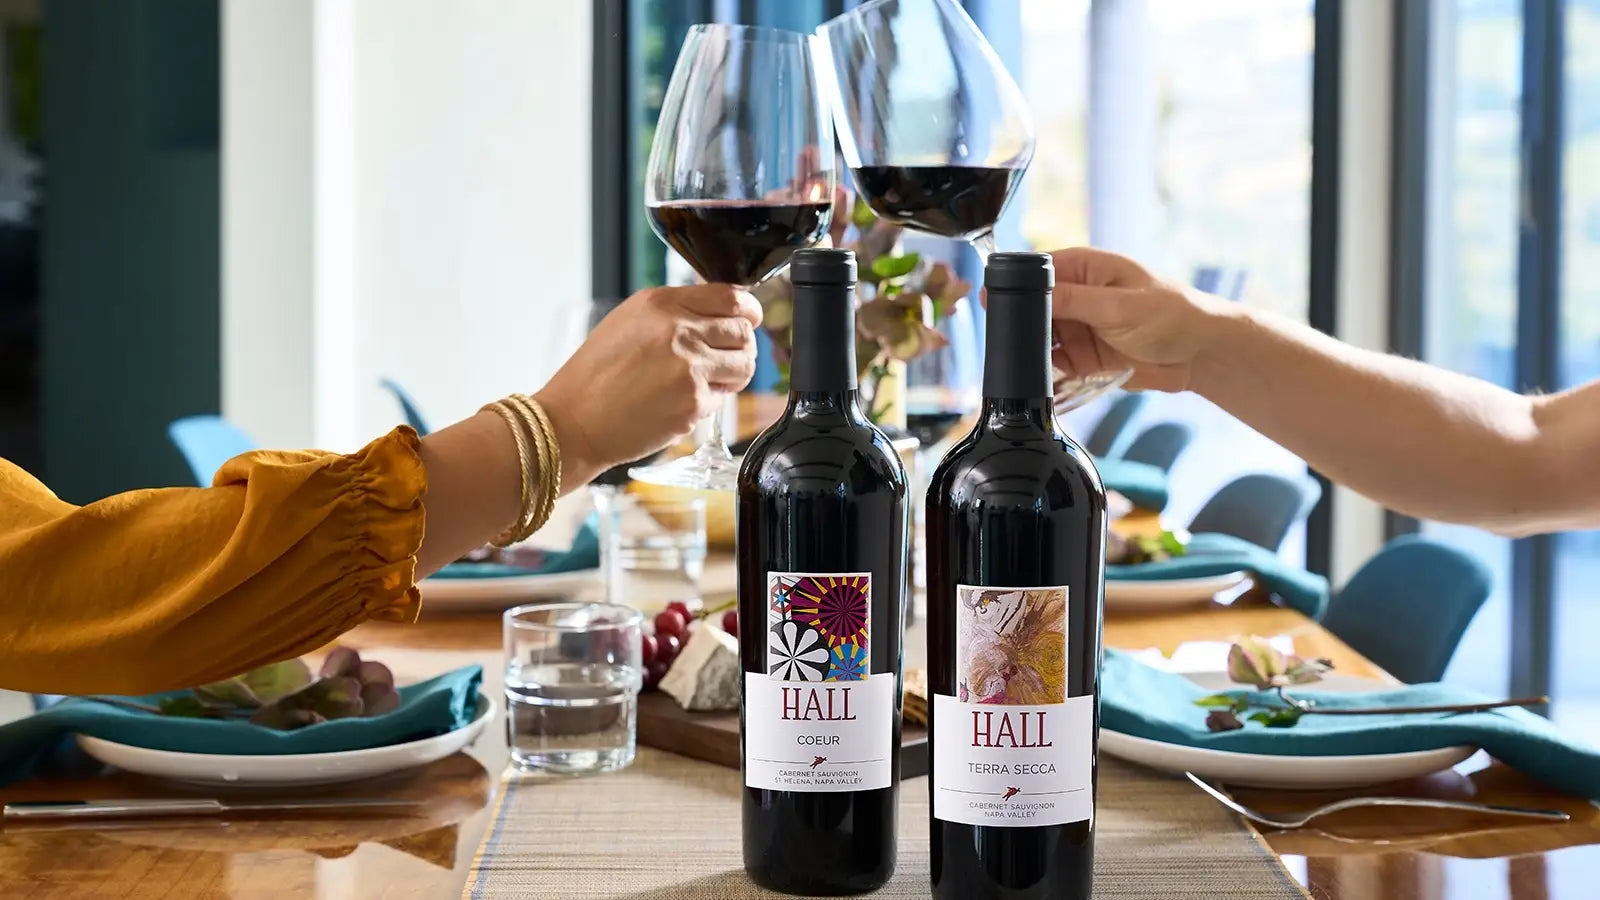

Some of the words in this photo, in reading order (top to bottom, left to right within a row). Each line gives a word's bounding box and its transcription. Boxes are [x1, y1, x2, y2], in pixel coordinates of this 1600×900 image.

[781, 687, 856, 720] HALL
[971, 711, 1052, 748] HALL
[797, 735, 840, 746] COEUR
[968, 762, 1010, 774] TERRA
[1014, 763, 1056, 774] SECCA
[969, 802, 1008, 810] CABERNET
[1010, 802, 1055, 810] SAUVIGNON
